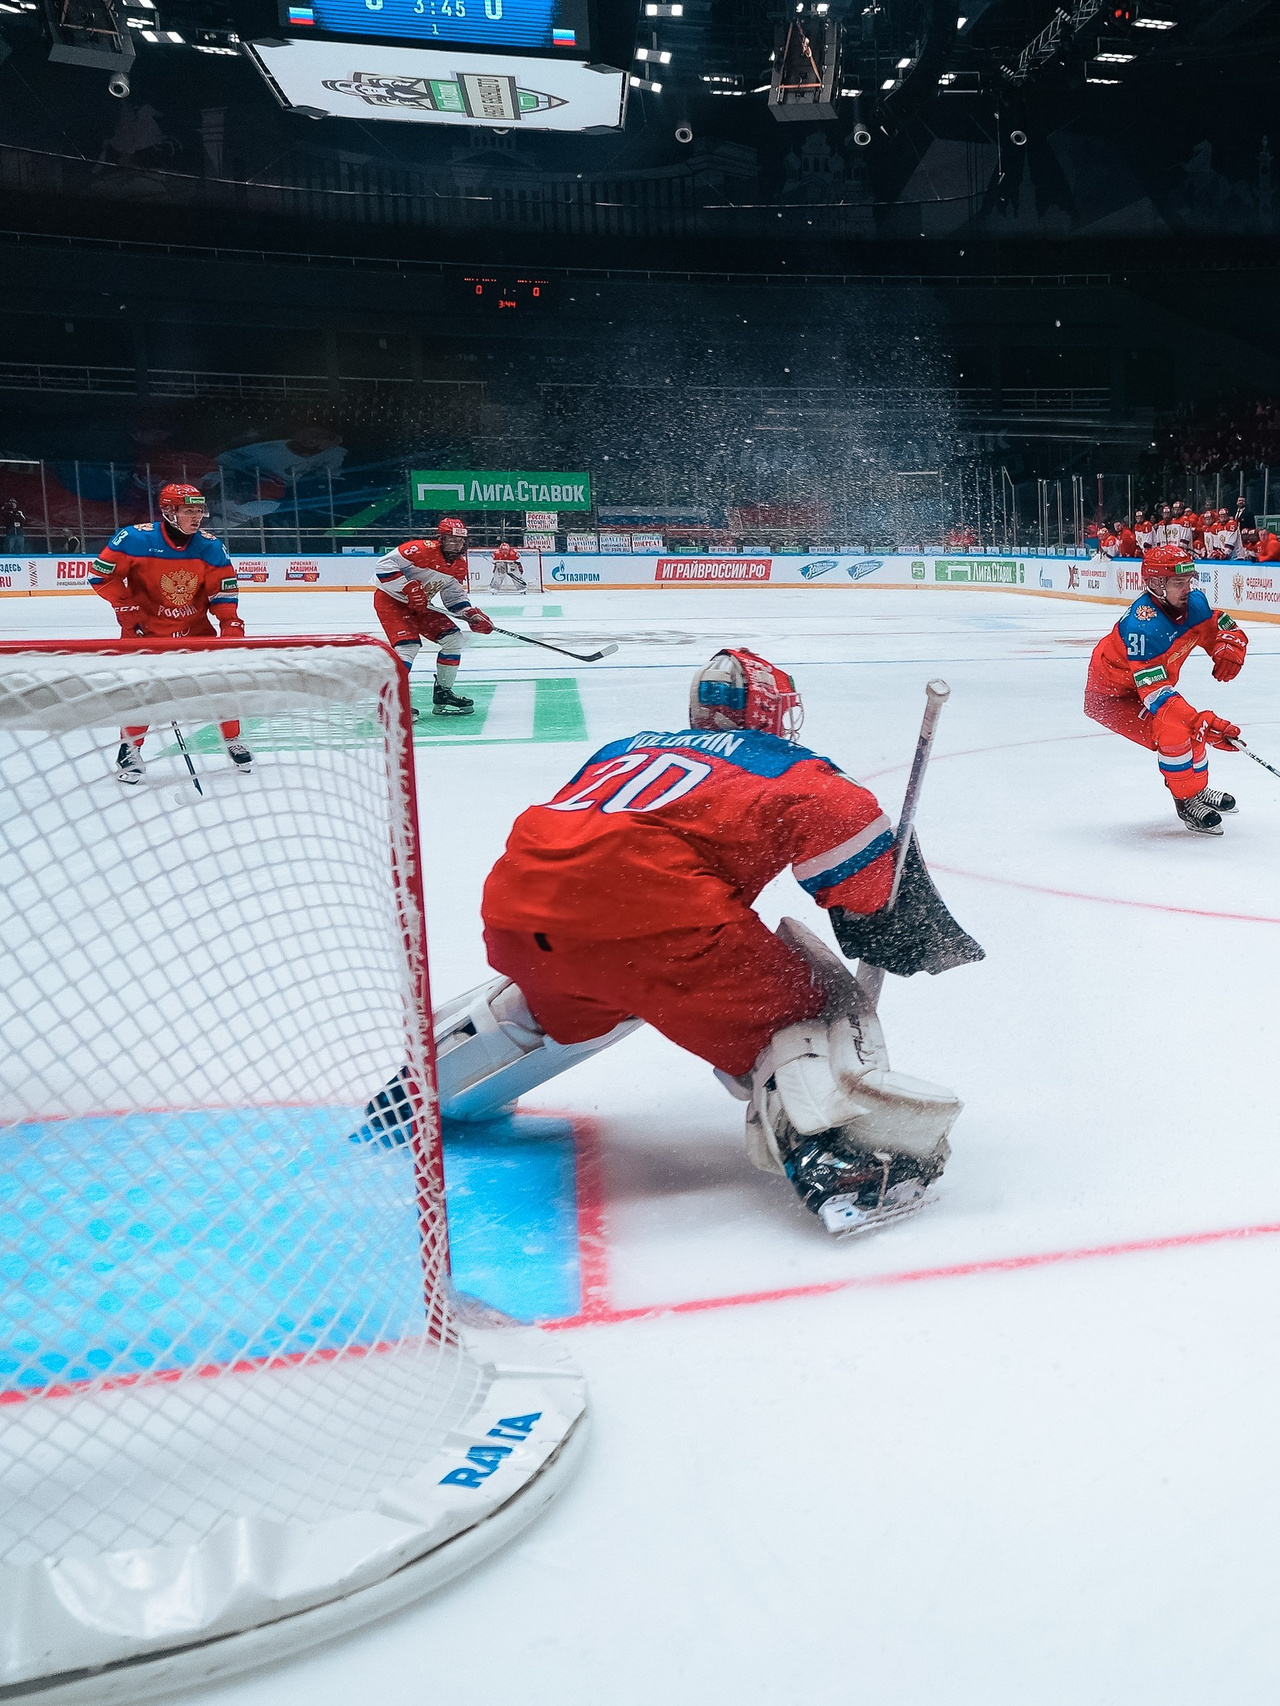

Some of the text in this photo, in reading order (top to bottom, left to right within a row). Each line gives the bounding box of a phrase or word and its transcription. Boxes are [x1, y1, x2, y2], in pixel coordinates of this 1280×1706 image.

[661, 560, 767, 579] ИГРАЙВРОССИИ.РФ
[1127, 633, 1146, 656] 31
[544, 752, 712, 814] 20
